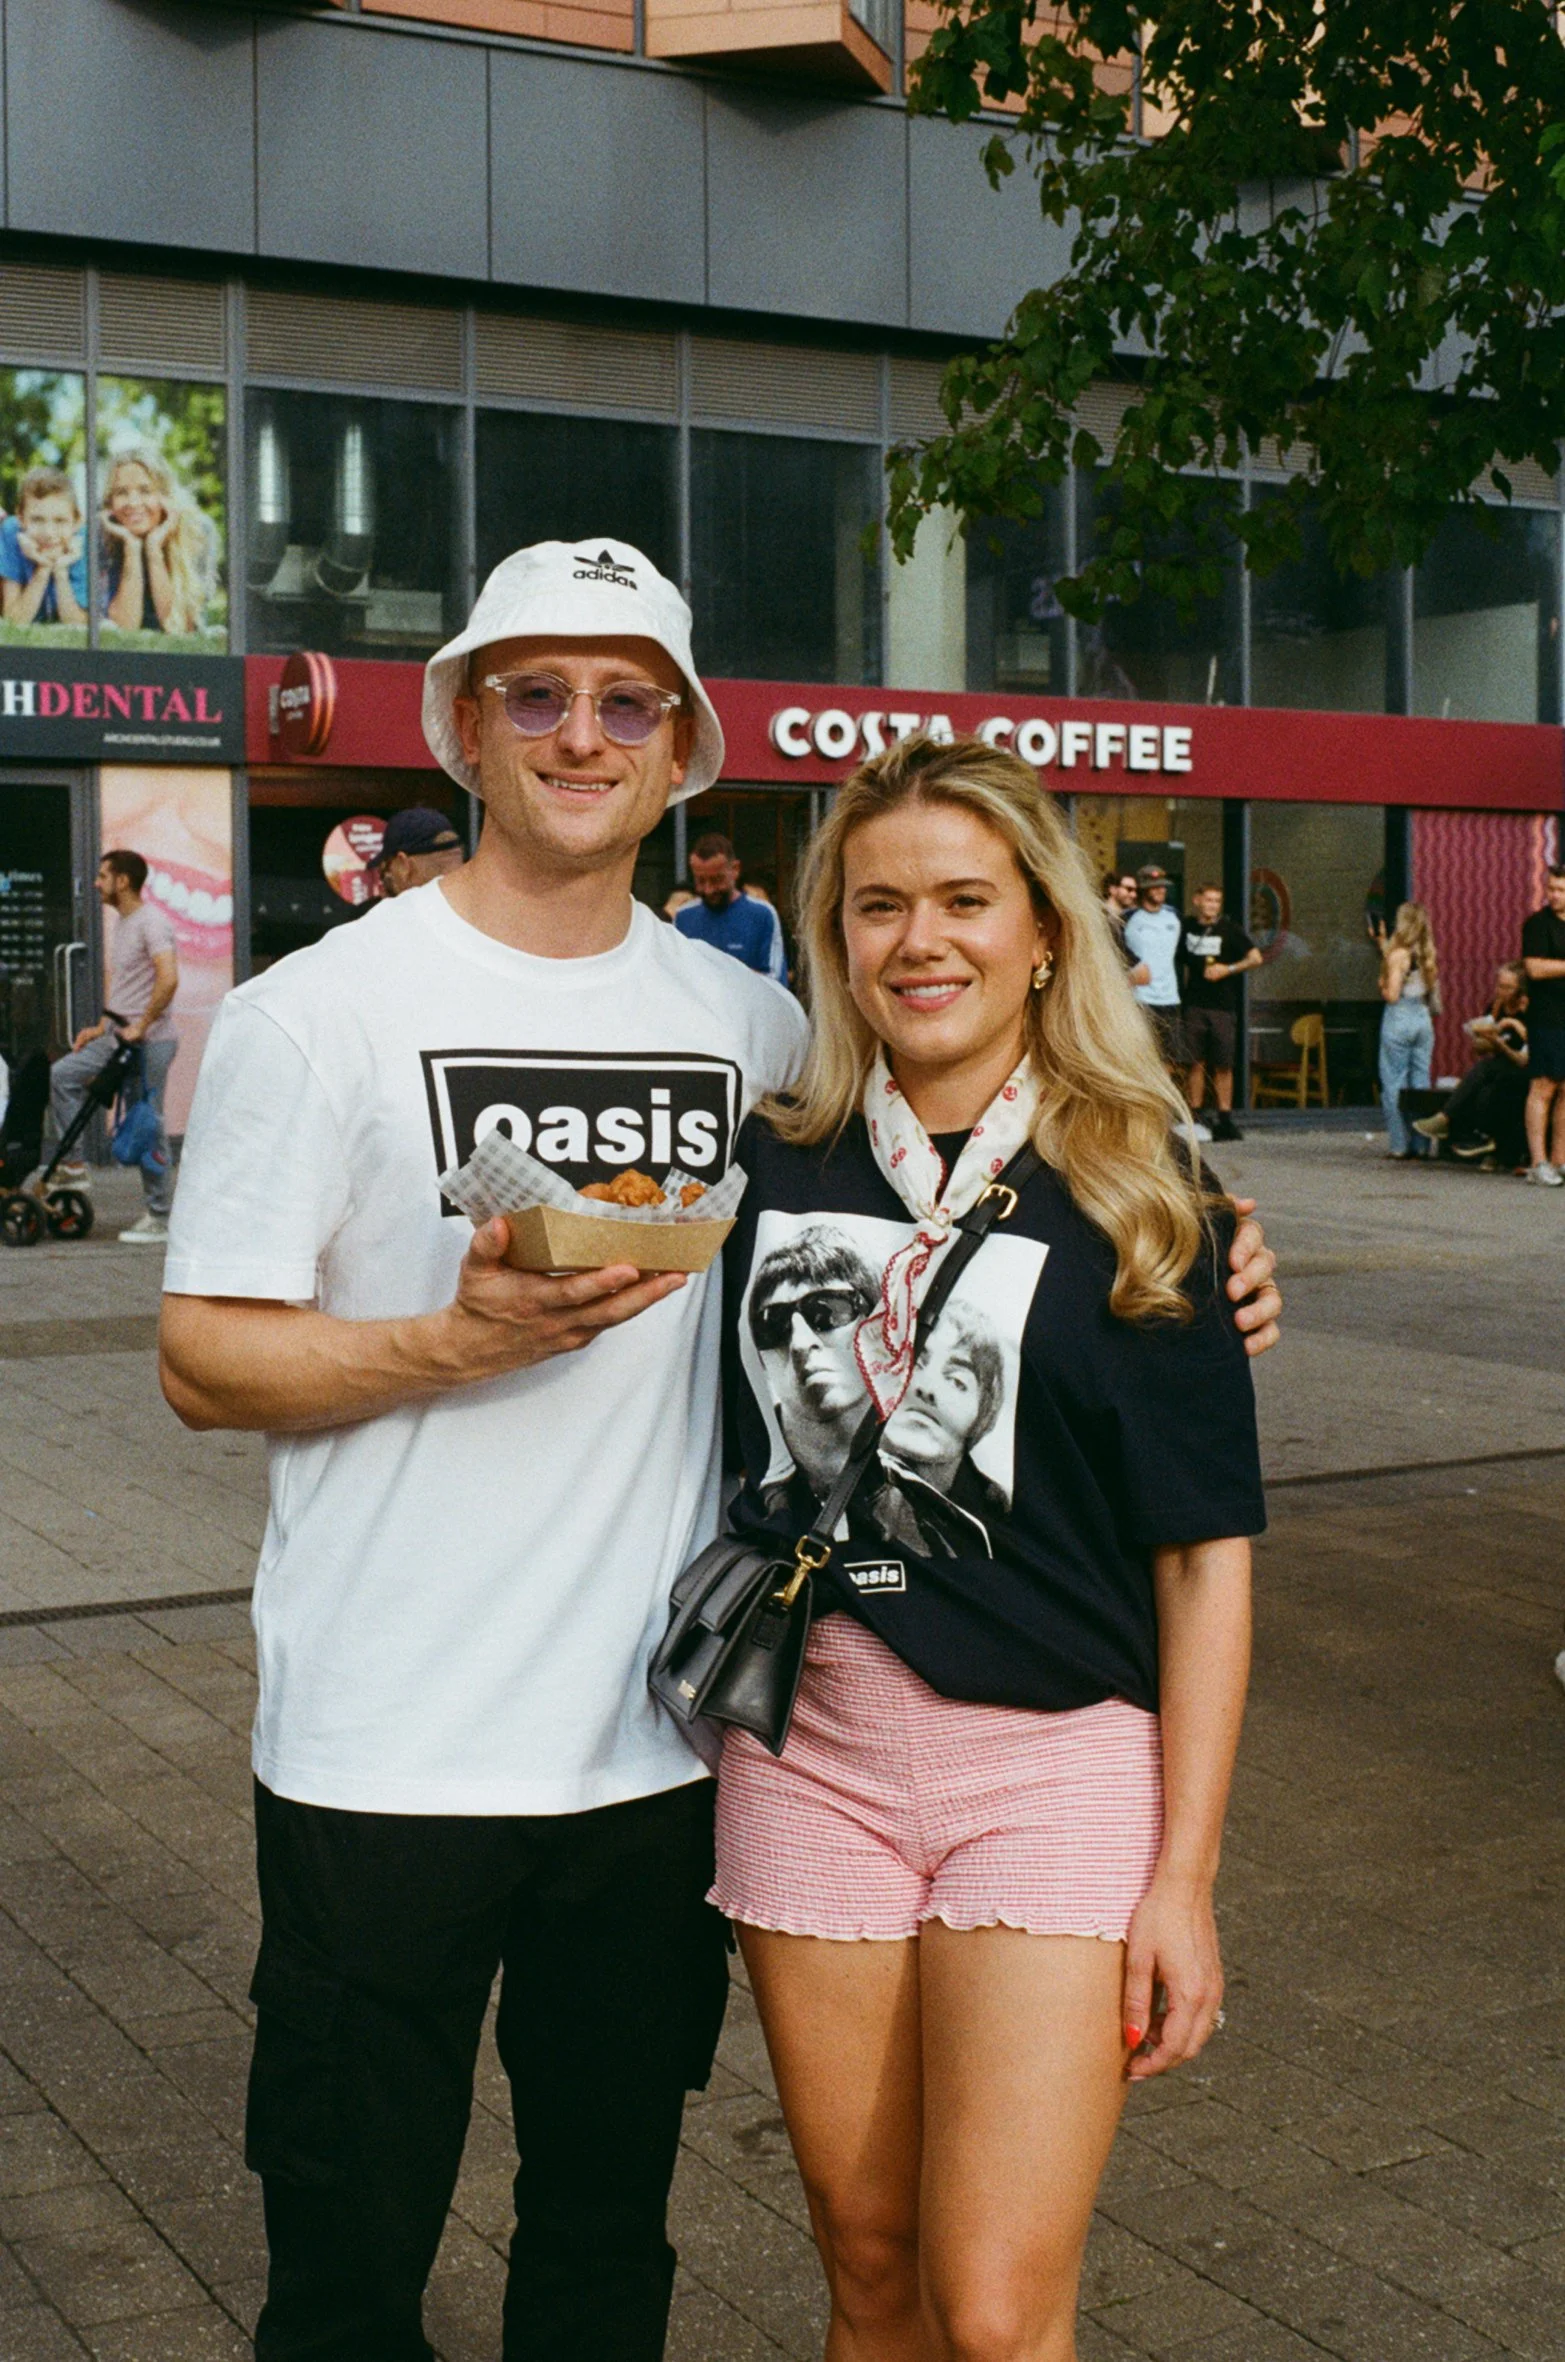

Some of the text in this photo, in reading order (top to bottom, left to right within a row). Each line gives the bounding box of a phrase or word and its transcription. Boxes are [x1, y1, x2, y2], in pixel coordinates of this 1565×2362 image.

[573, 568, 638, 591] adidas
[976, 716, 1193, 772] COFFEE
[474, 1088, 719, 1168] oasis
